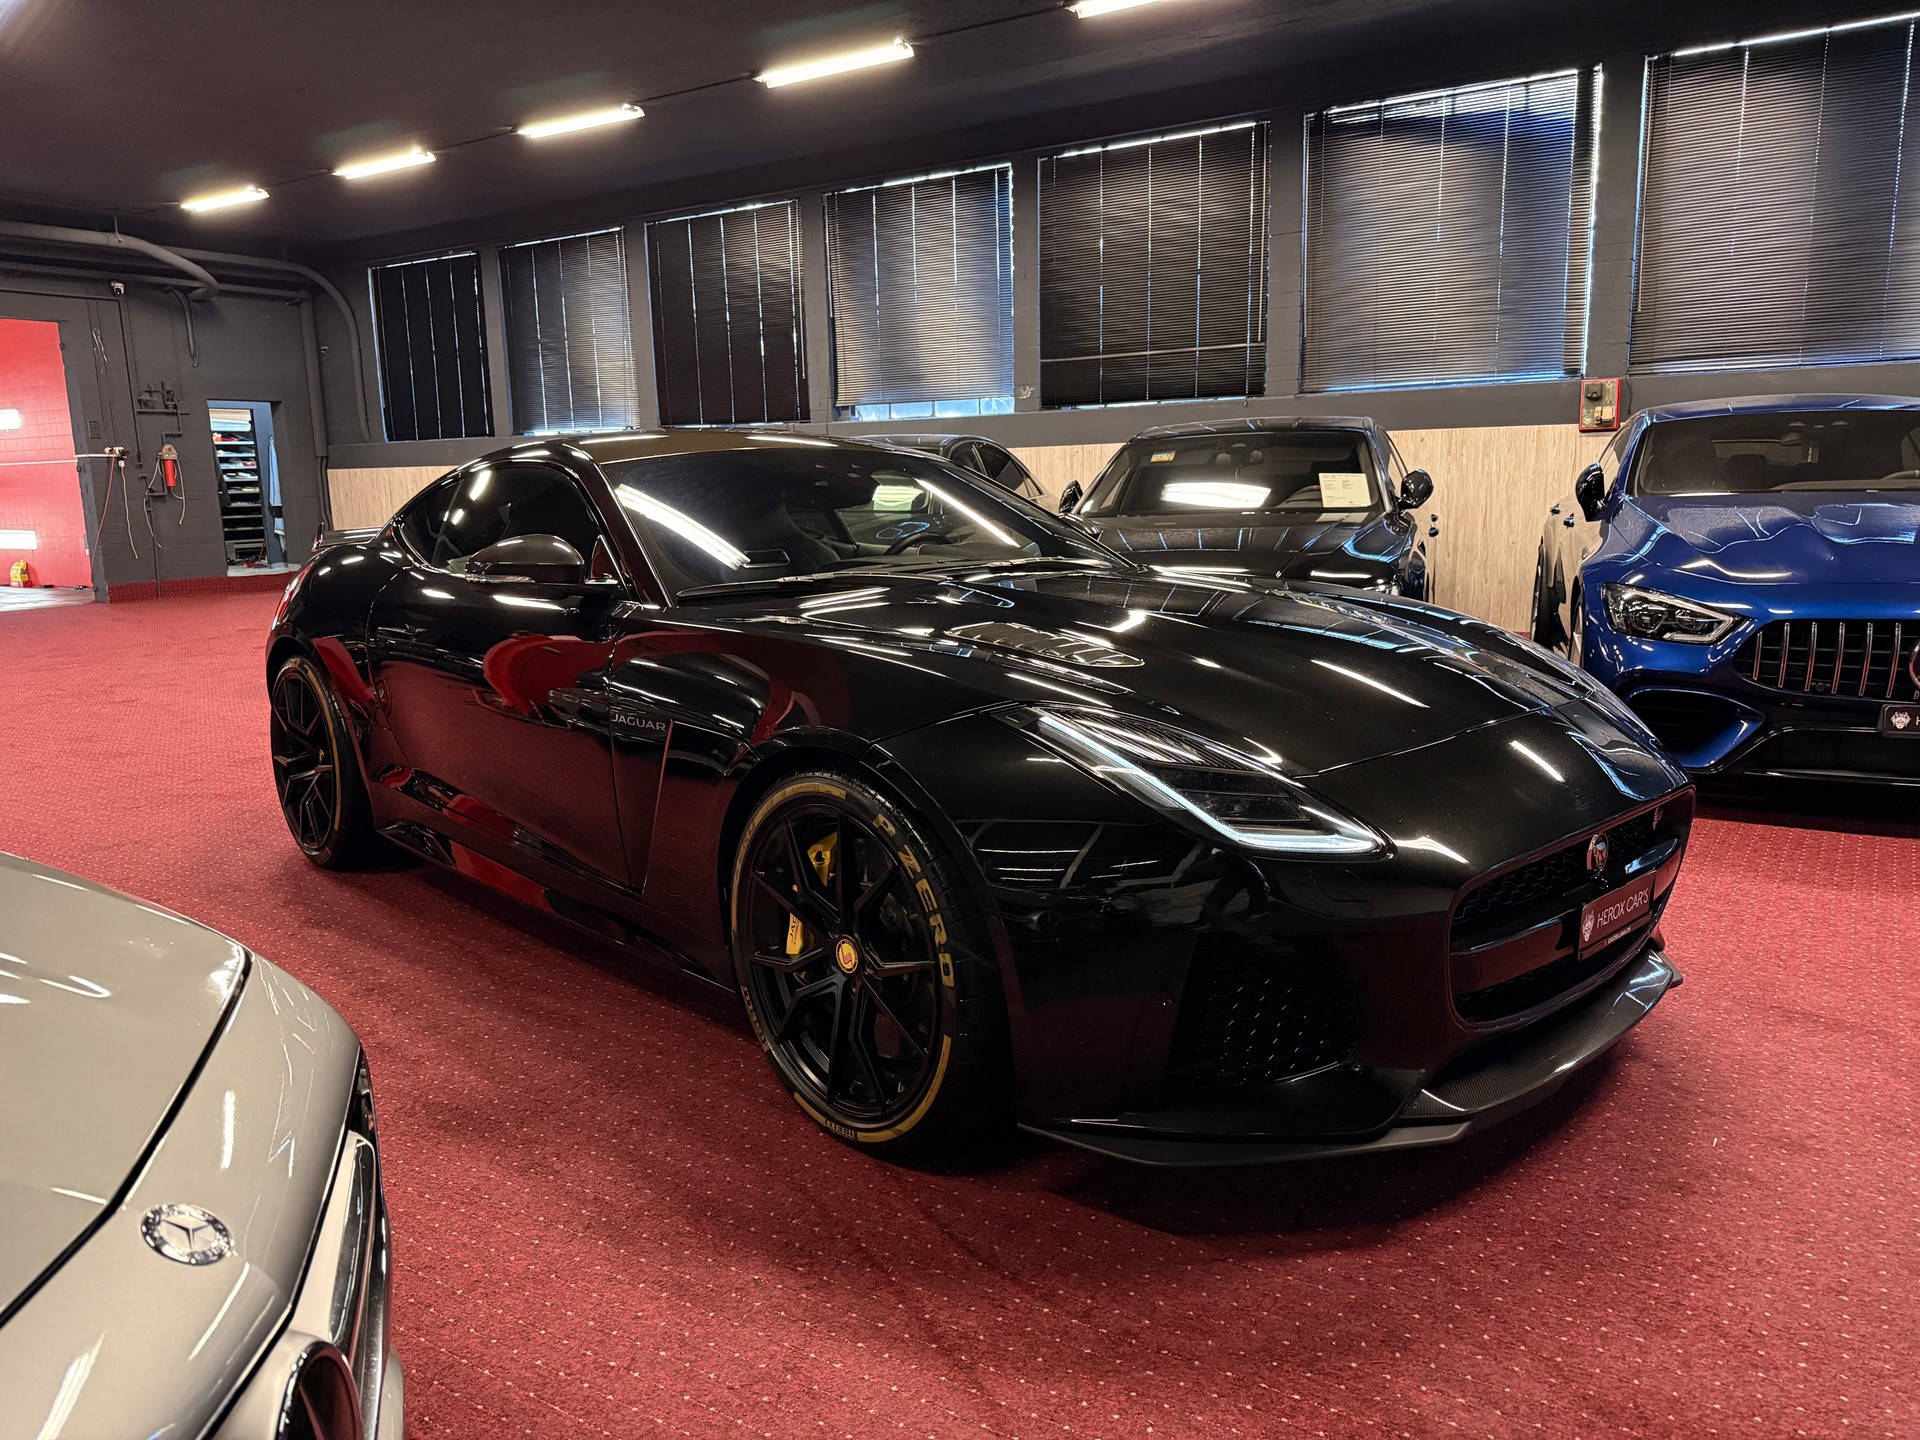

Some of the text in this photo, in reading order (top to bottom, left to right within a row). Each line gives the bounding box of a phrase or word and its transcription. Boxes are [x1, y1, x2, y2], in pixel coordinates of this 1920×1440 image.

[611, 713, 666, 732] JAGUAR
[872, 813, 955, 988] P ZERO
[1596, 900, 1626, 928] HEROX
